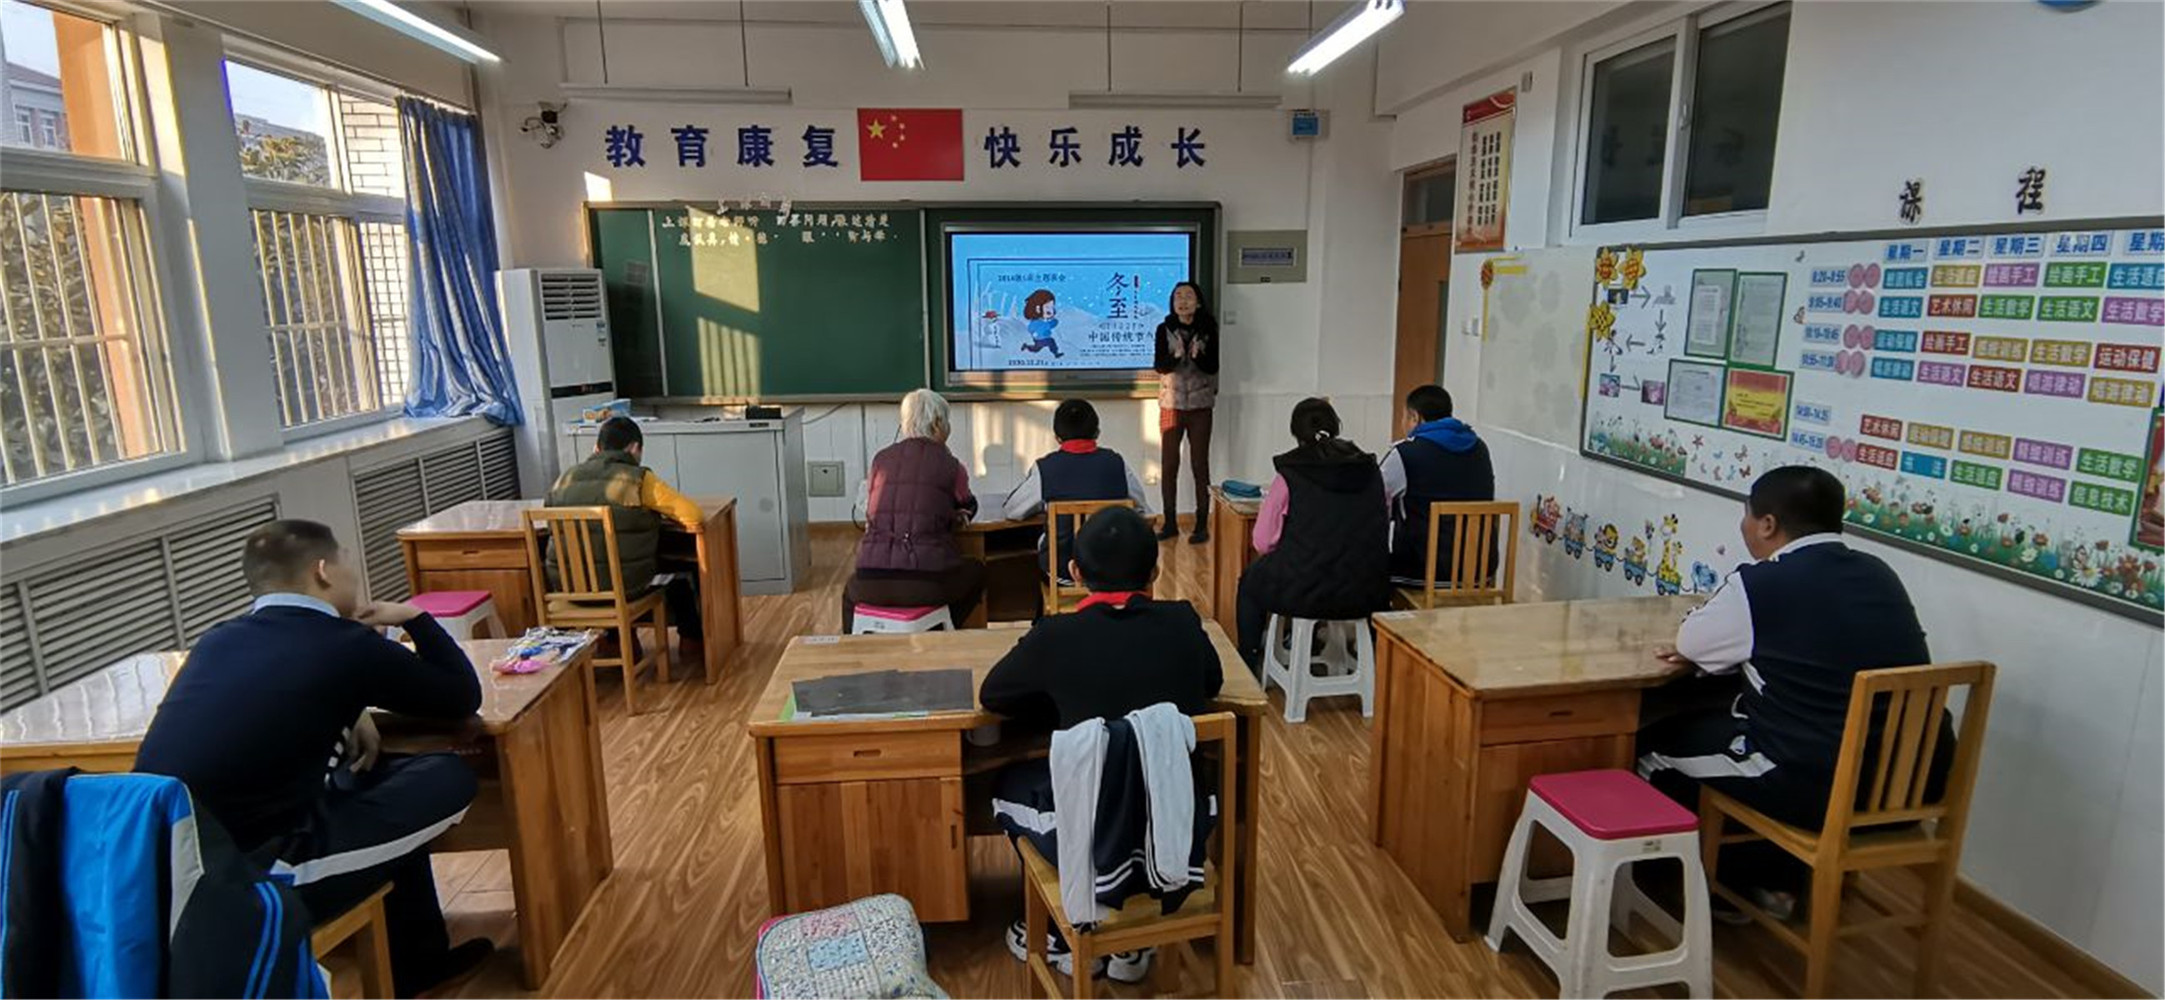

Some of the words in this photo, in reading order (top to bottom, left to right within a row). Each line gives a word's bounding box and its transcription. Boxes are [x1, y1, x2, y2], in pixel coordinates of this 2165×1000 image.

[605, 125, 839, 168] 教育康复
[984, 126, 1207, 169] 快乐成长
[1887, 244, 1925, 260] 星期一
[1938, 239, 1980, 256] 星期二
[1994, 237, 2040, 255] 星期三
[2056, 234, 2109, 253] 星期四
[1985, 265, 2036, 285] 绘画手工
[2047, 264, 2101, 285] 绘画手工
[1106, 272, 1129, 318] 冬至
[1881, 300, 1921, 316] 生活语文
[1930, 298, 1975, 315] 艺术休闲
[1981, 297, 2030, 316] 生活数学
[2041, 299, 2094, 319] 生活语文
[2106, 300, 2165, 322] 生活数学
[1924, 333, 1968, 352] 绘画手工
[2034, 342, 2087, 364] 生活数学
[2099, 347, 2156, 370] 运动保健
[1919, 364, 1962, 384] 生活语文
[1970, 368, 2018, 389] 生活语文
[2028, 372, 2081, 395] 唱游律动
[2094, 380, 2151, 405] 唱游律动
[1858, 445, 1896, 469] 生活适应
[1953, 463, 1998, 488] 生活适应
[2073, 484, 2130, 513] 信息技术
[2080, 451, 2138, 479] 生活数学
